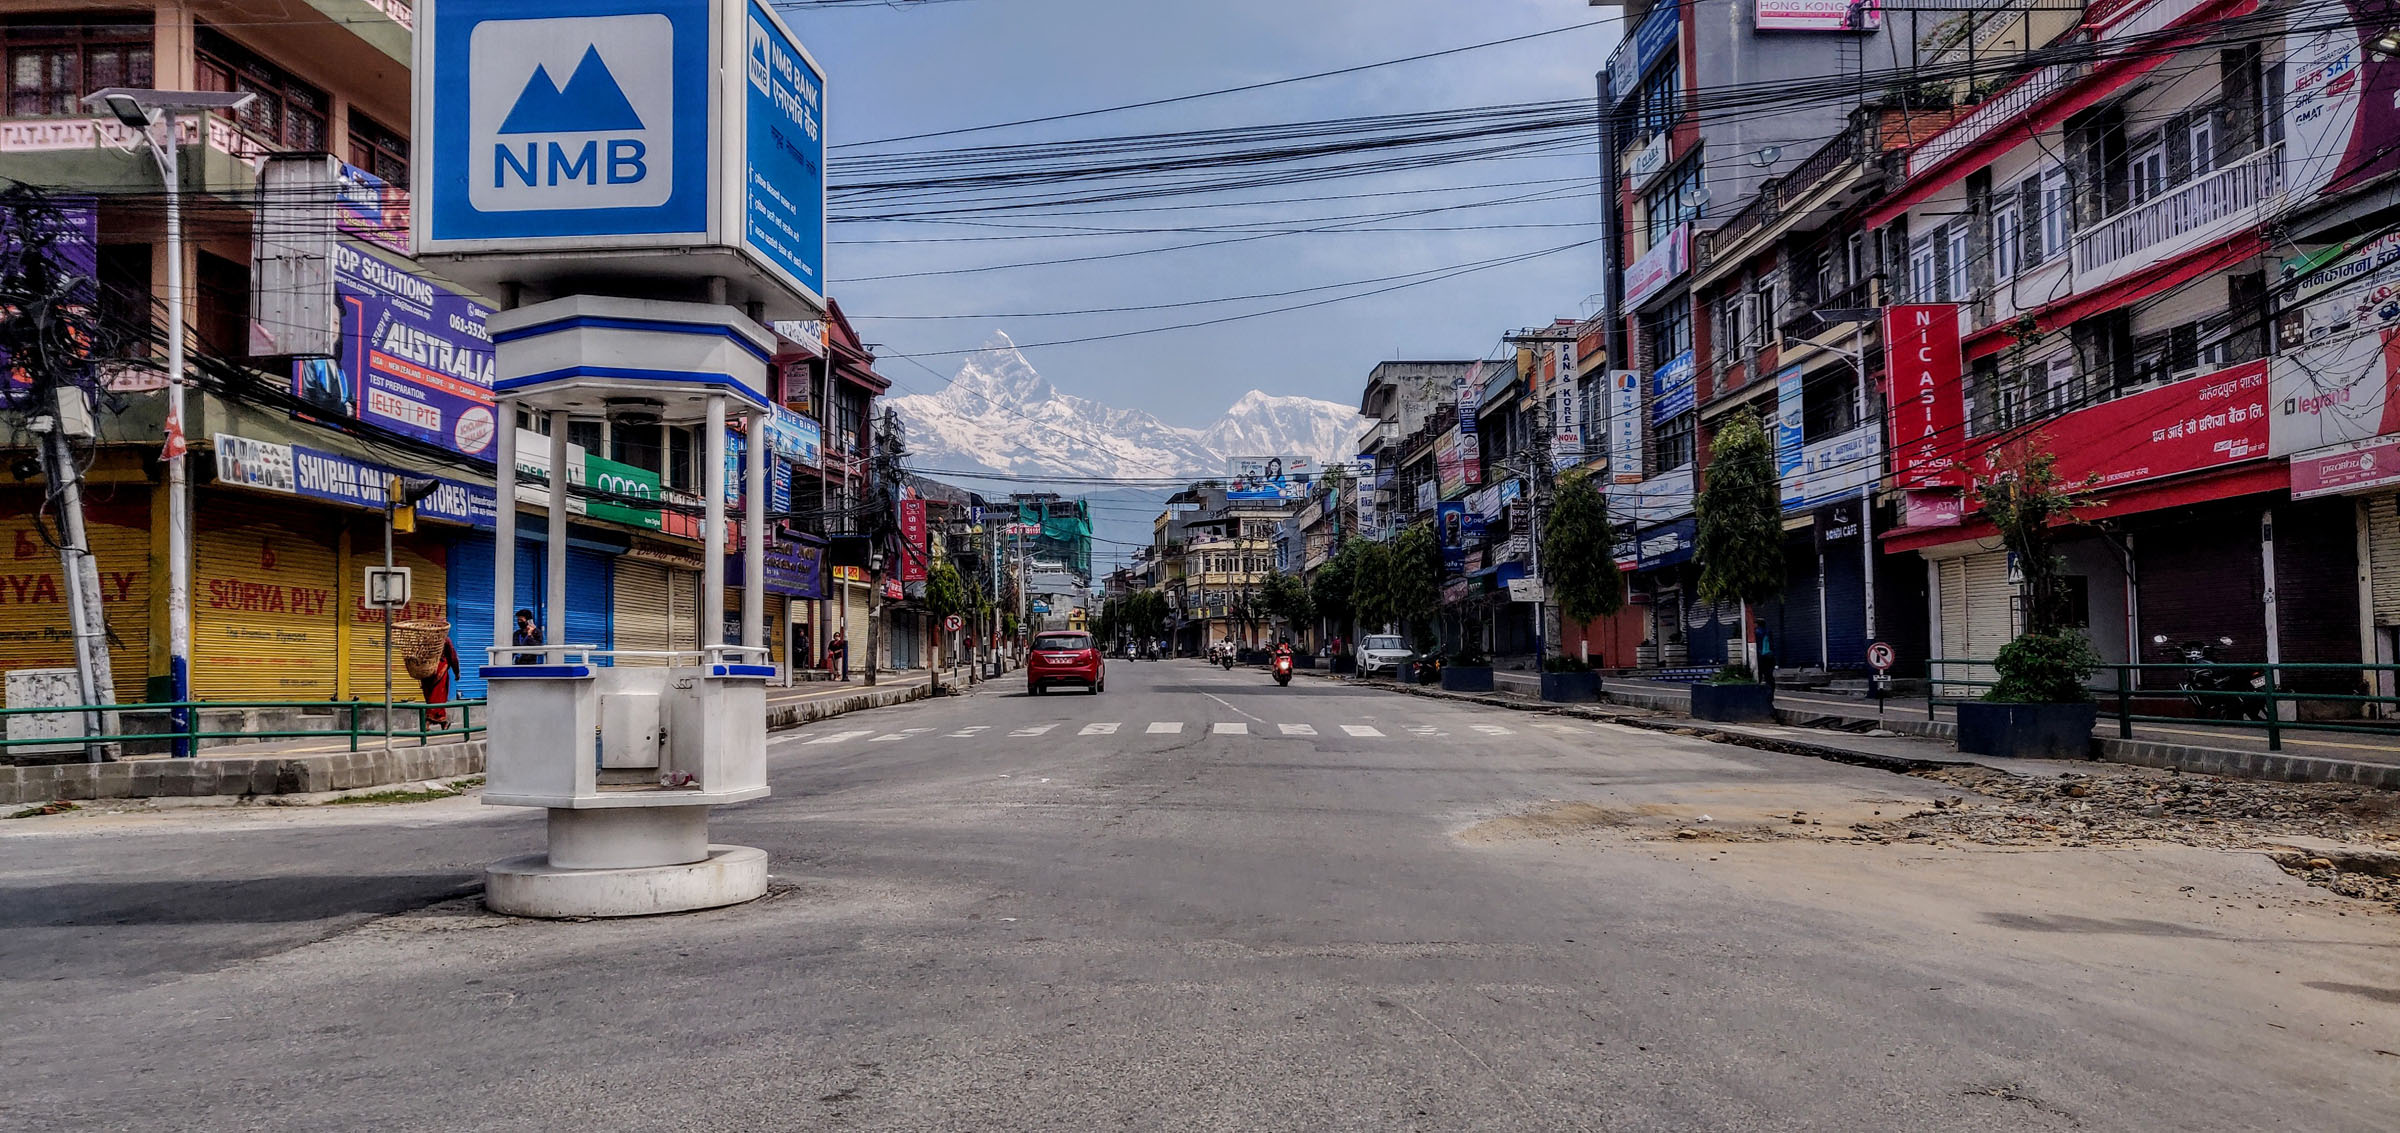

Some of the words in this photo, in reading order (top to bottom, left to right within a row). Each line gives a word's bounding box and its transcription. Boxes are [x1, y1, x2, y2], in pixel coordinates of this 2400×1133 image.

[1760, 1, 1800, 11] HONG
[1804, 2, 1844, 11] KONG
[751, 56, 768, 87] NMB
[771, 40, 793, 83] NMB
[793, 66, 818, 113] BANK
[2295, 69, 2322, 93] IELTS
[2326, 54, 2351, 78] SAT
[2295, 104, 2324, 122] GMAT
[493, 138, 648, 189] NMB
[333, 243, 360, 273] TOP
[361, 256, 434, 307] SOLUTIONS
[2301, 256, 2372, 289] मनकामना
[382, 319, 495, 387] AUSTRALIA
[369, 373, 384, 388] TEST
[371, 391, 403, 418] IELTS
[416, 406, 437, 427] PTE
[1563, 388, 1573, 433] KOREA
[2298, 389, 2351, 416] legrand
[777, 409, 797, 425] BLUE
[799, 417, 817, 433] BIRD
[1928, 458, 1953, 468] ASIA
[298, 453, 359, 498] SHUBHA
[359, 467, 383, 502] OM
[425, 482, 468, 518] STORES
[1936, 501, 1960, 512] ATM
[1842, 523, 1858, 537] CAFE
[291, 586, 328, 616] PLY
